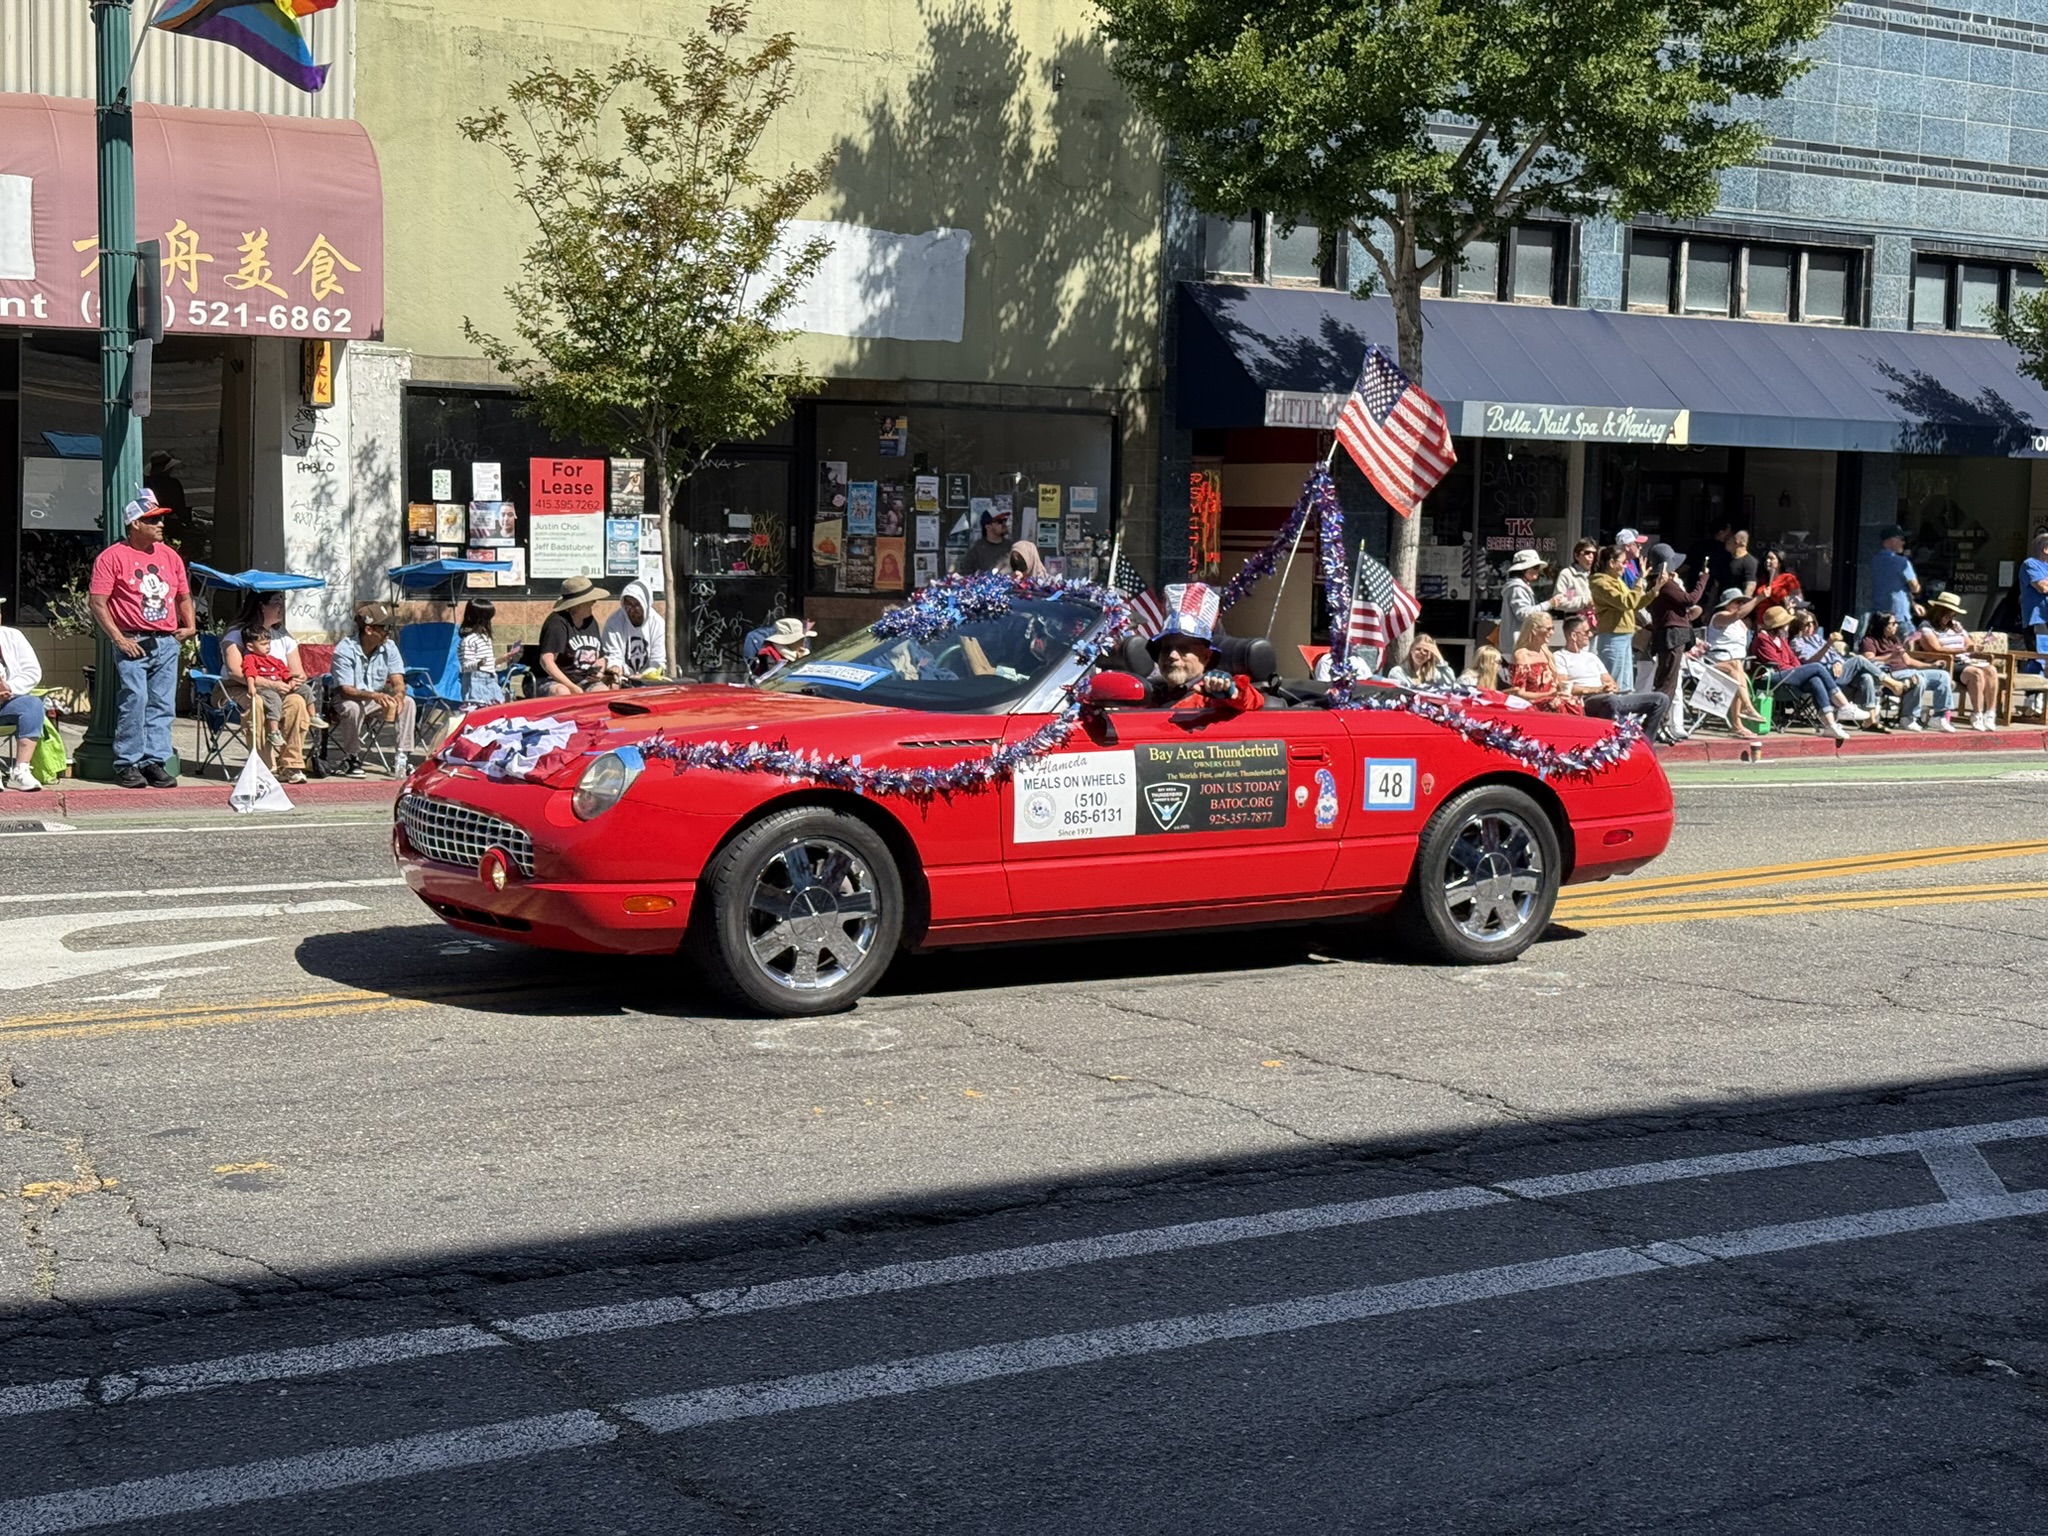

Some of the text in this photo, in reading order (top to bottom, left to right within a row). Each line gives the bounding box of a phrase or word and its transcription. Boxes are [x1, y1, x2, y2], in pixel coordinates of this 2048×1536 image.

[188, 300, 352, 333] 521-6862
[1487, 405, 1531, 433] Bella
[1532, 407, 1569, 436] Nail
[1572, 410, 1598, 440] Spa
[1602, 410, 1615, 437] &
[2031, 435, 2048, 452] TO
[552, 462, 583, 477] For
[541, 479, 594, 495] Lease
[535, 499, 600, 510] 415.395.7262
[534, 522, 580, 531] Justin Choi
[1505, 518, 1534, 536] TK
[534, 543, 595, 552] Jeff Badstubner
[1149, 743, 1279, 763] Bay Area Thunderbird
[1036, 756, 1088, 776] Alameda
[1193, 760, 1241, 768] OWNERS CLUB
[1024, 773, 1126, 790] MEALS ON WHEELS
[1200, 781, 1282, 795] JOIN US TODAY
[1378, 772, 1403, 798] 48
[1074, 792, 1108, 808] (510)
[1210, 796, 1273, 810] BATOC.ORG
[1064, 808, 1122, 825] 865-6131
[1209, 812, 1273, 826] 925-357-7877
[1058, 828, 1093, 837] Since 1973
